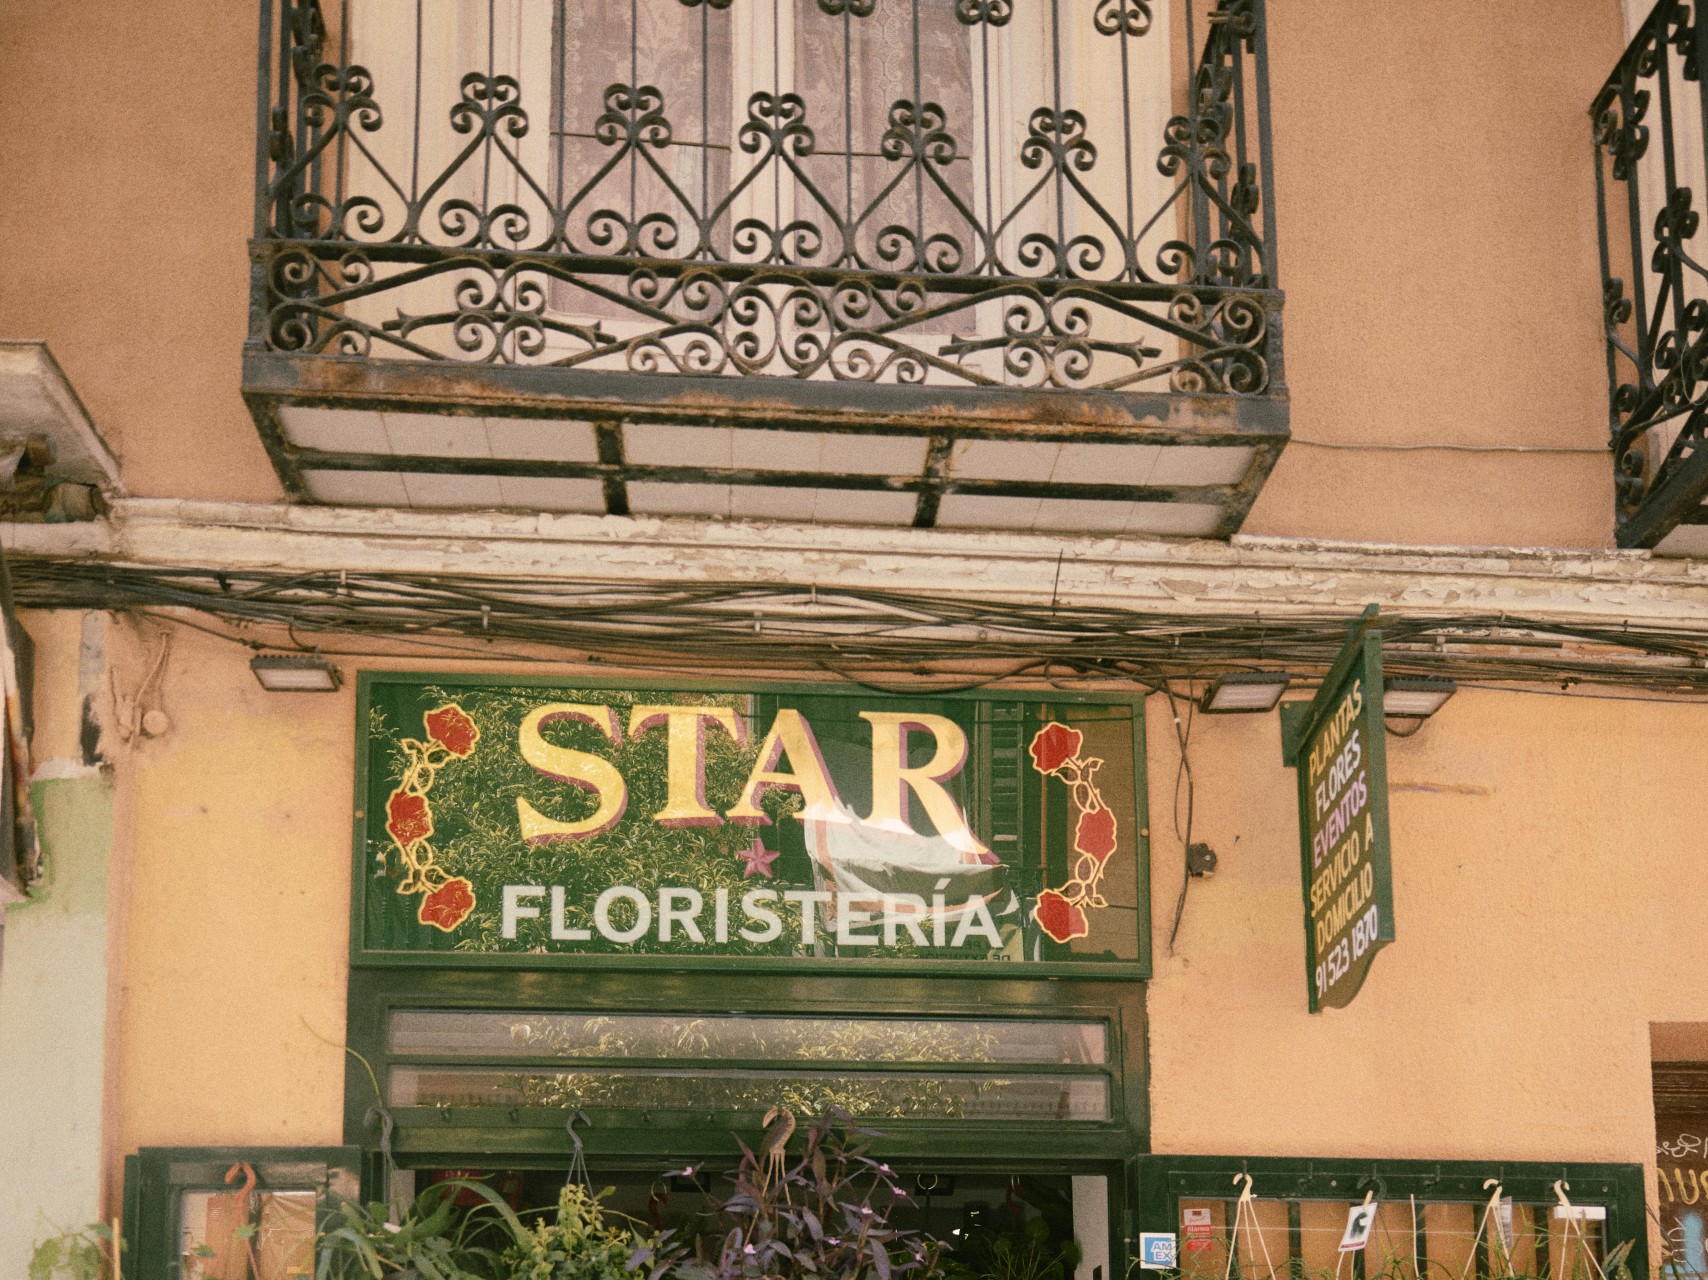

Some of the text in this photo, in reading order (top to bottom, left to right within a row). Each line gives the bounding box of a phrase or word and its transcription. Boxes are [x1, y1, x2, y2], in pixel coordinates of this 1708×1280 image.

[1309, 679, 1362, 786] PLANTAS
[1315, 729, 1360, 821] FLORES
[515, 702, 999, 865] STAR
[1314, 770, 1367, 869] EVENTOS
[1310, 812, 1374, 918] SERVICIO A
[1317, 861, 1373, 955] DOMICILIO
[501, 877, 1004, 948] FLORISTERÍA
[1315, 904, 1378, 999] 91 523 1870
[1151, 1240, 1173, 1252] AM
[1154, 1251, 1173, 1261] EX
